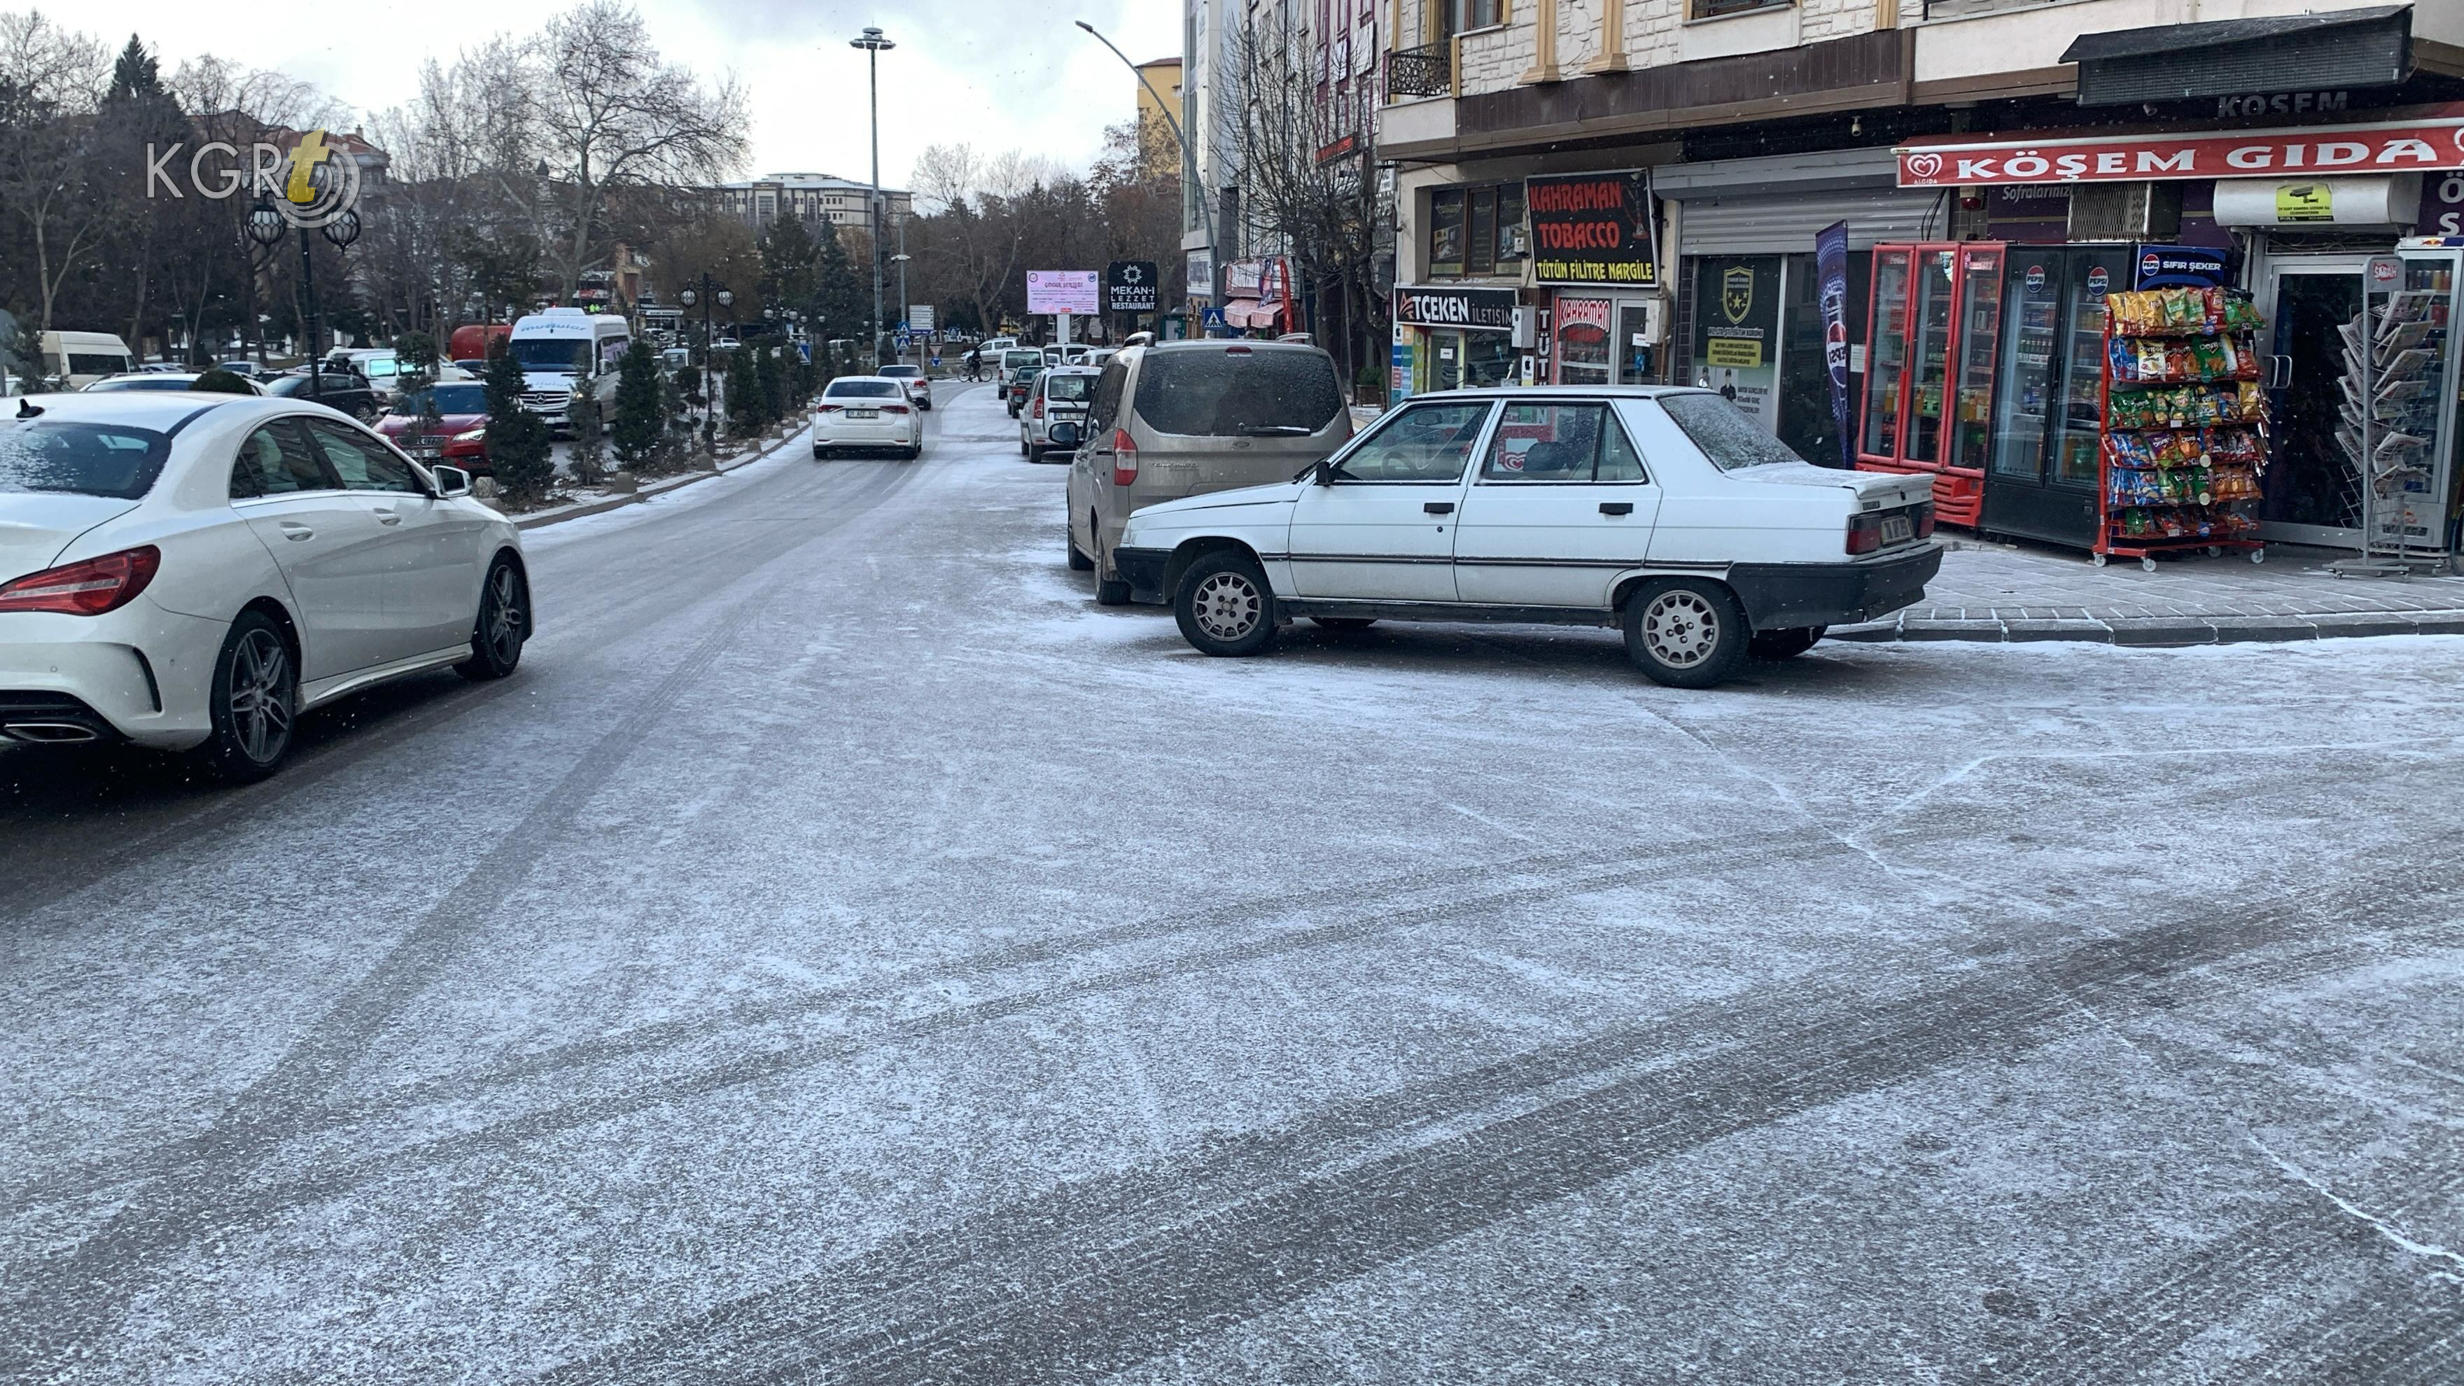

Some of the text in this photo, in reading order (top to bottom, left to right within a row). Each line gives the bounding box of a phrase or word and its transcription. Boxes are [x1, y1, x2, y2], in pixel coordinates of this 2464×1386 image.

[1957, 139, 2438, 181] KÖŞEM GIDA
[1529, 181, 1623, 212] KAHRAMAN
[1539, 221, 1620, 250] TOBACCO
[1536, 258, 1653, 281] TÜTÜN FİLİTRE NARGİLE
[2026, 274, 2045, 283] PEPSI
[2189, 261, 2221, 272] ŞEKER
[2088, 278, 2109, 286] PEPSI
[1112, 301, 1155, 310] RESTAURANT
[1559, 299, 1611, 333] KAHRAMAN
[1538, 309, 1550, 386] TÜT
